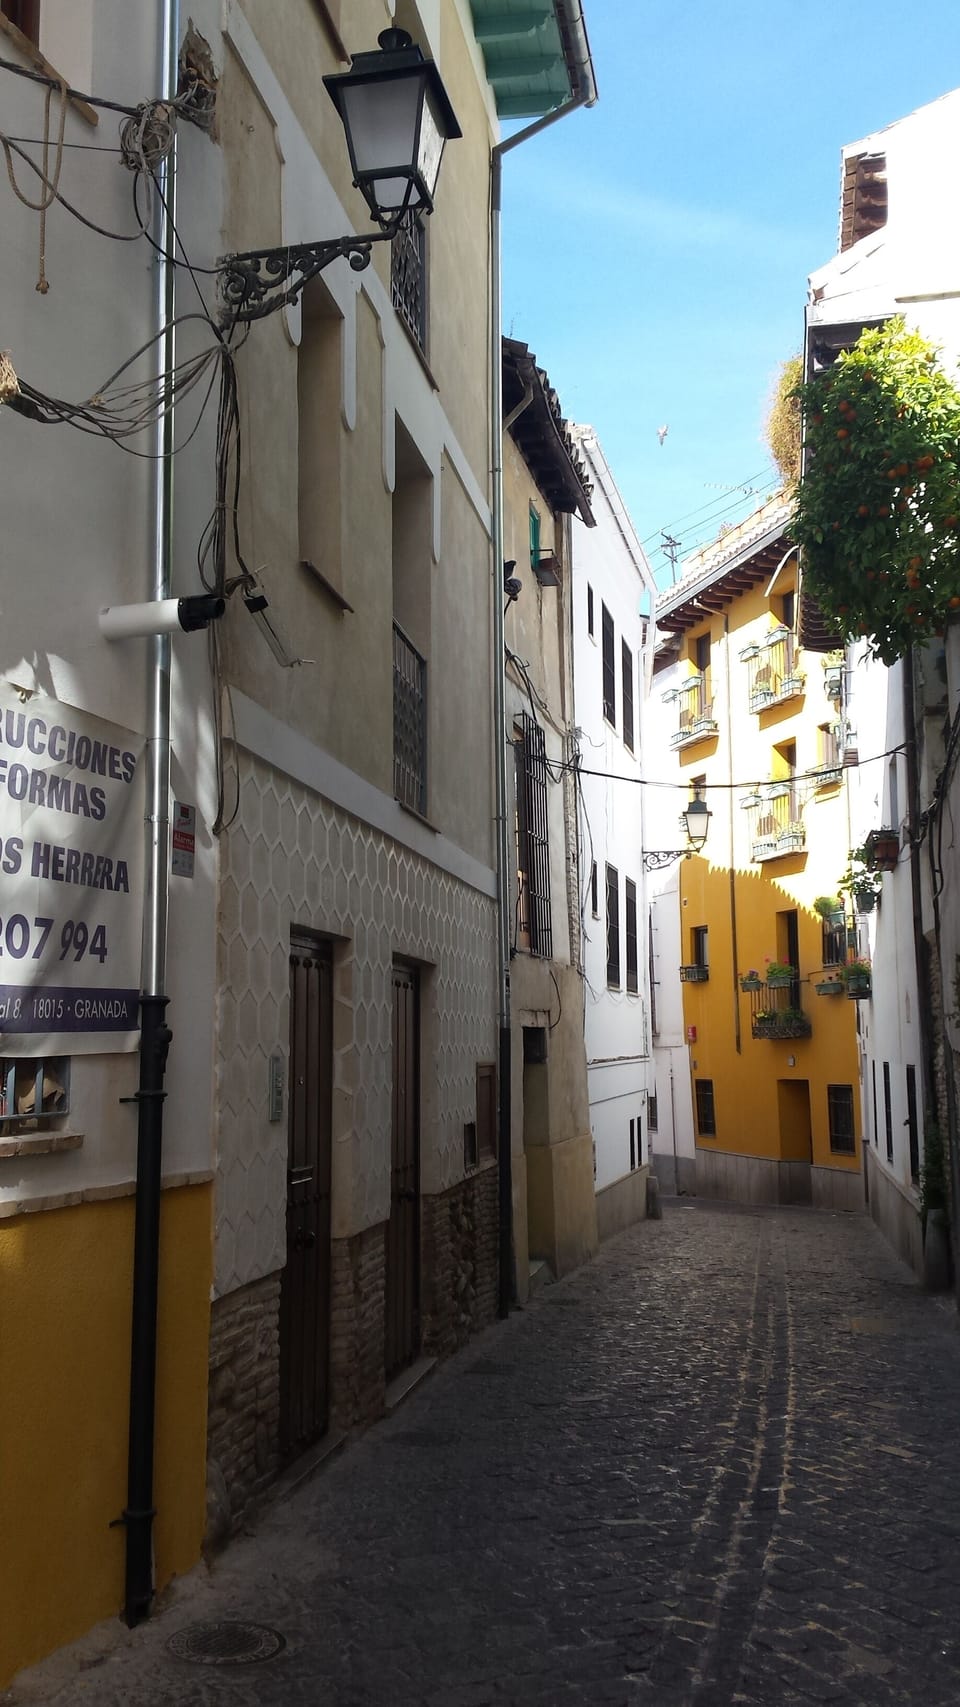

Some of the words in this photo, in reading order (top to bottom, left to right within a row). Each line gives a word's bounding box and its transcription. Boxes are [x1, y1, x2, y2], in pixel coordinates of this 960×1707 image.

[0, 708, 136, 784] UCCIONES
[0, 836, 24, 875] S
[31, 841, 129, 893] HERRERA
[0, 913, 54, 959] 07
[59, 919, 107, 963] 994
[33, 999, 64, 1018] 18015
[74, 999, 128, 1018] GRANADA
